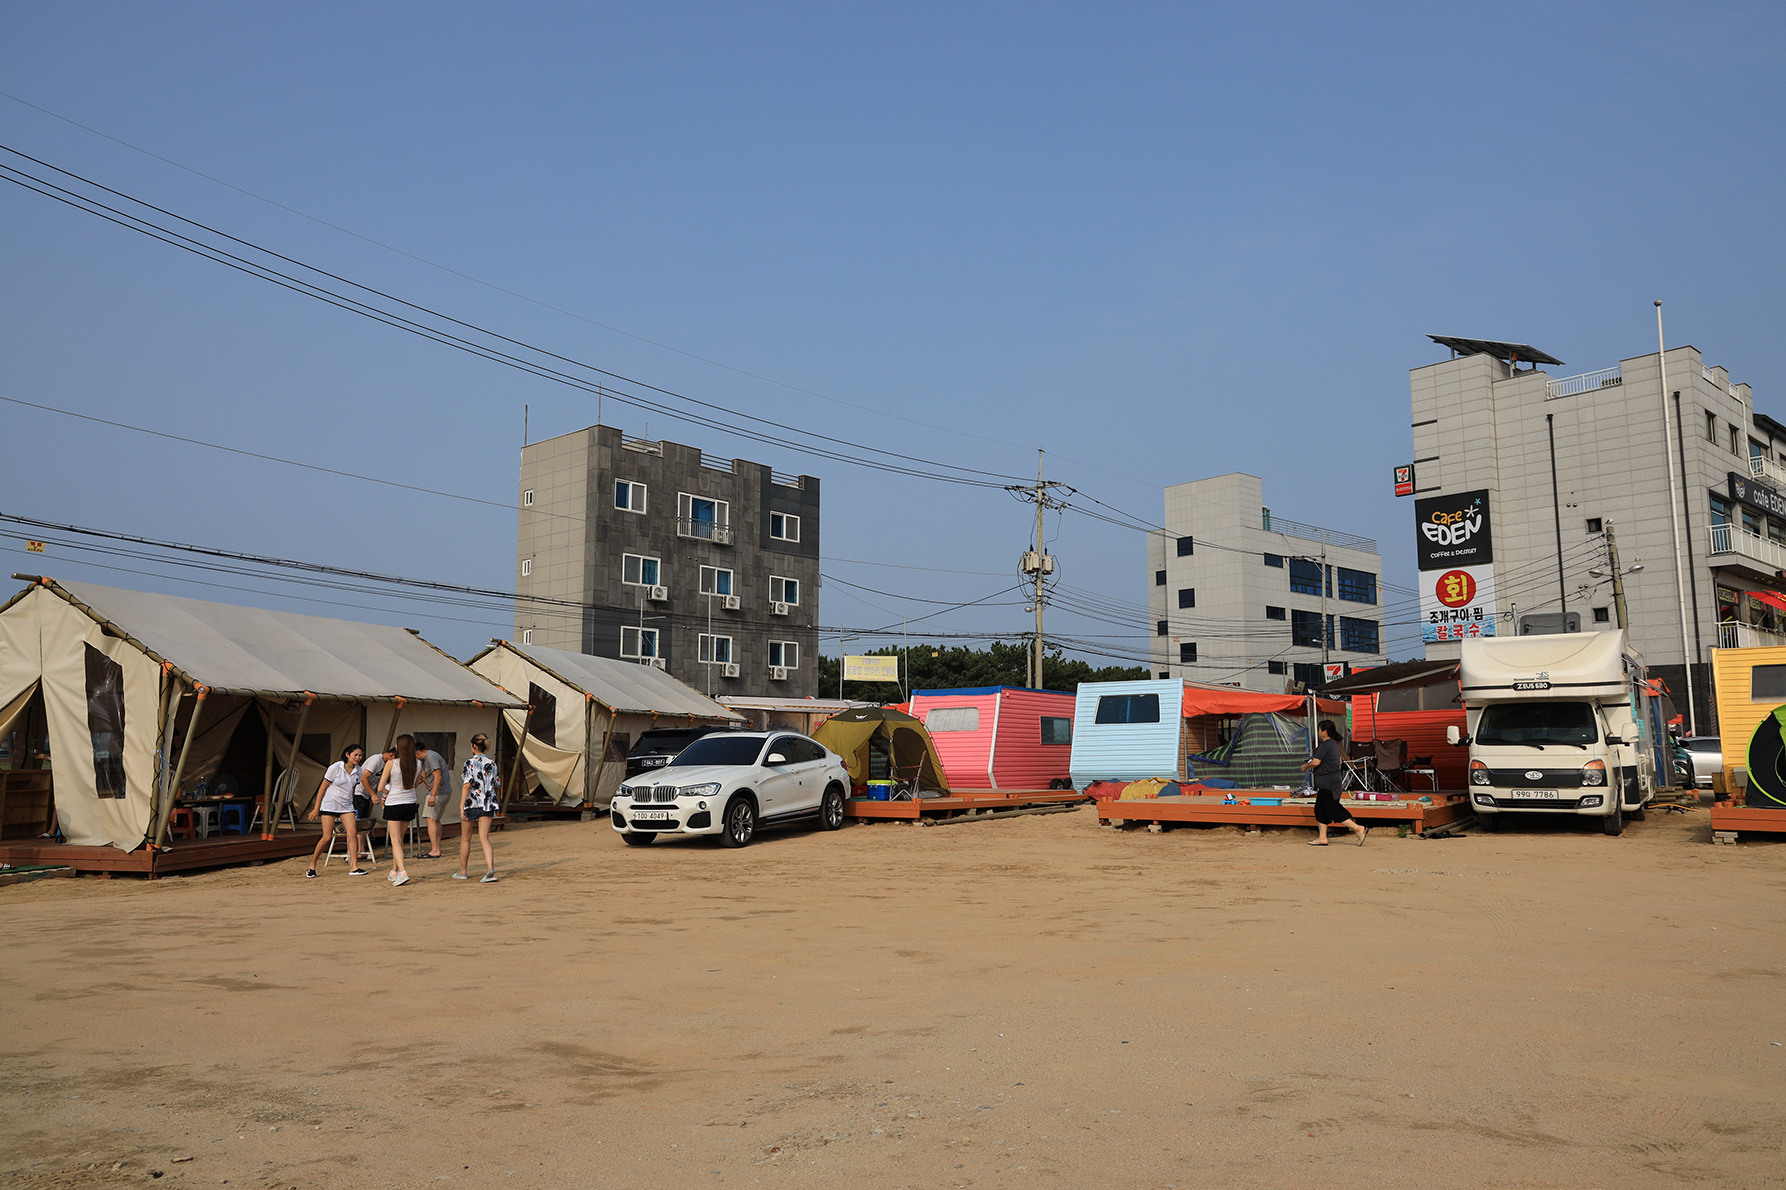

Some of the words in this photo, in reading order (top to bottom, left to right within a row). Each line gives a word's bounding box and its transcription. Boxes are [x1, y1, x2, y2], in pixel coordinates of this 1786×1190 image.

[1753, 489, 1770, 508] cafe
[1431, 510, 1463, 526] Cafe
[1421, 514, 1482, 546] EDEN
[1444, 574, 1468, 602] 회
[1437, 623, 1480, 640] 칼국수
